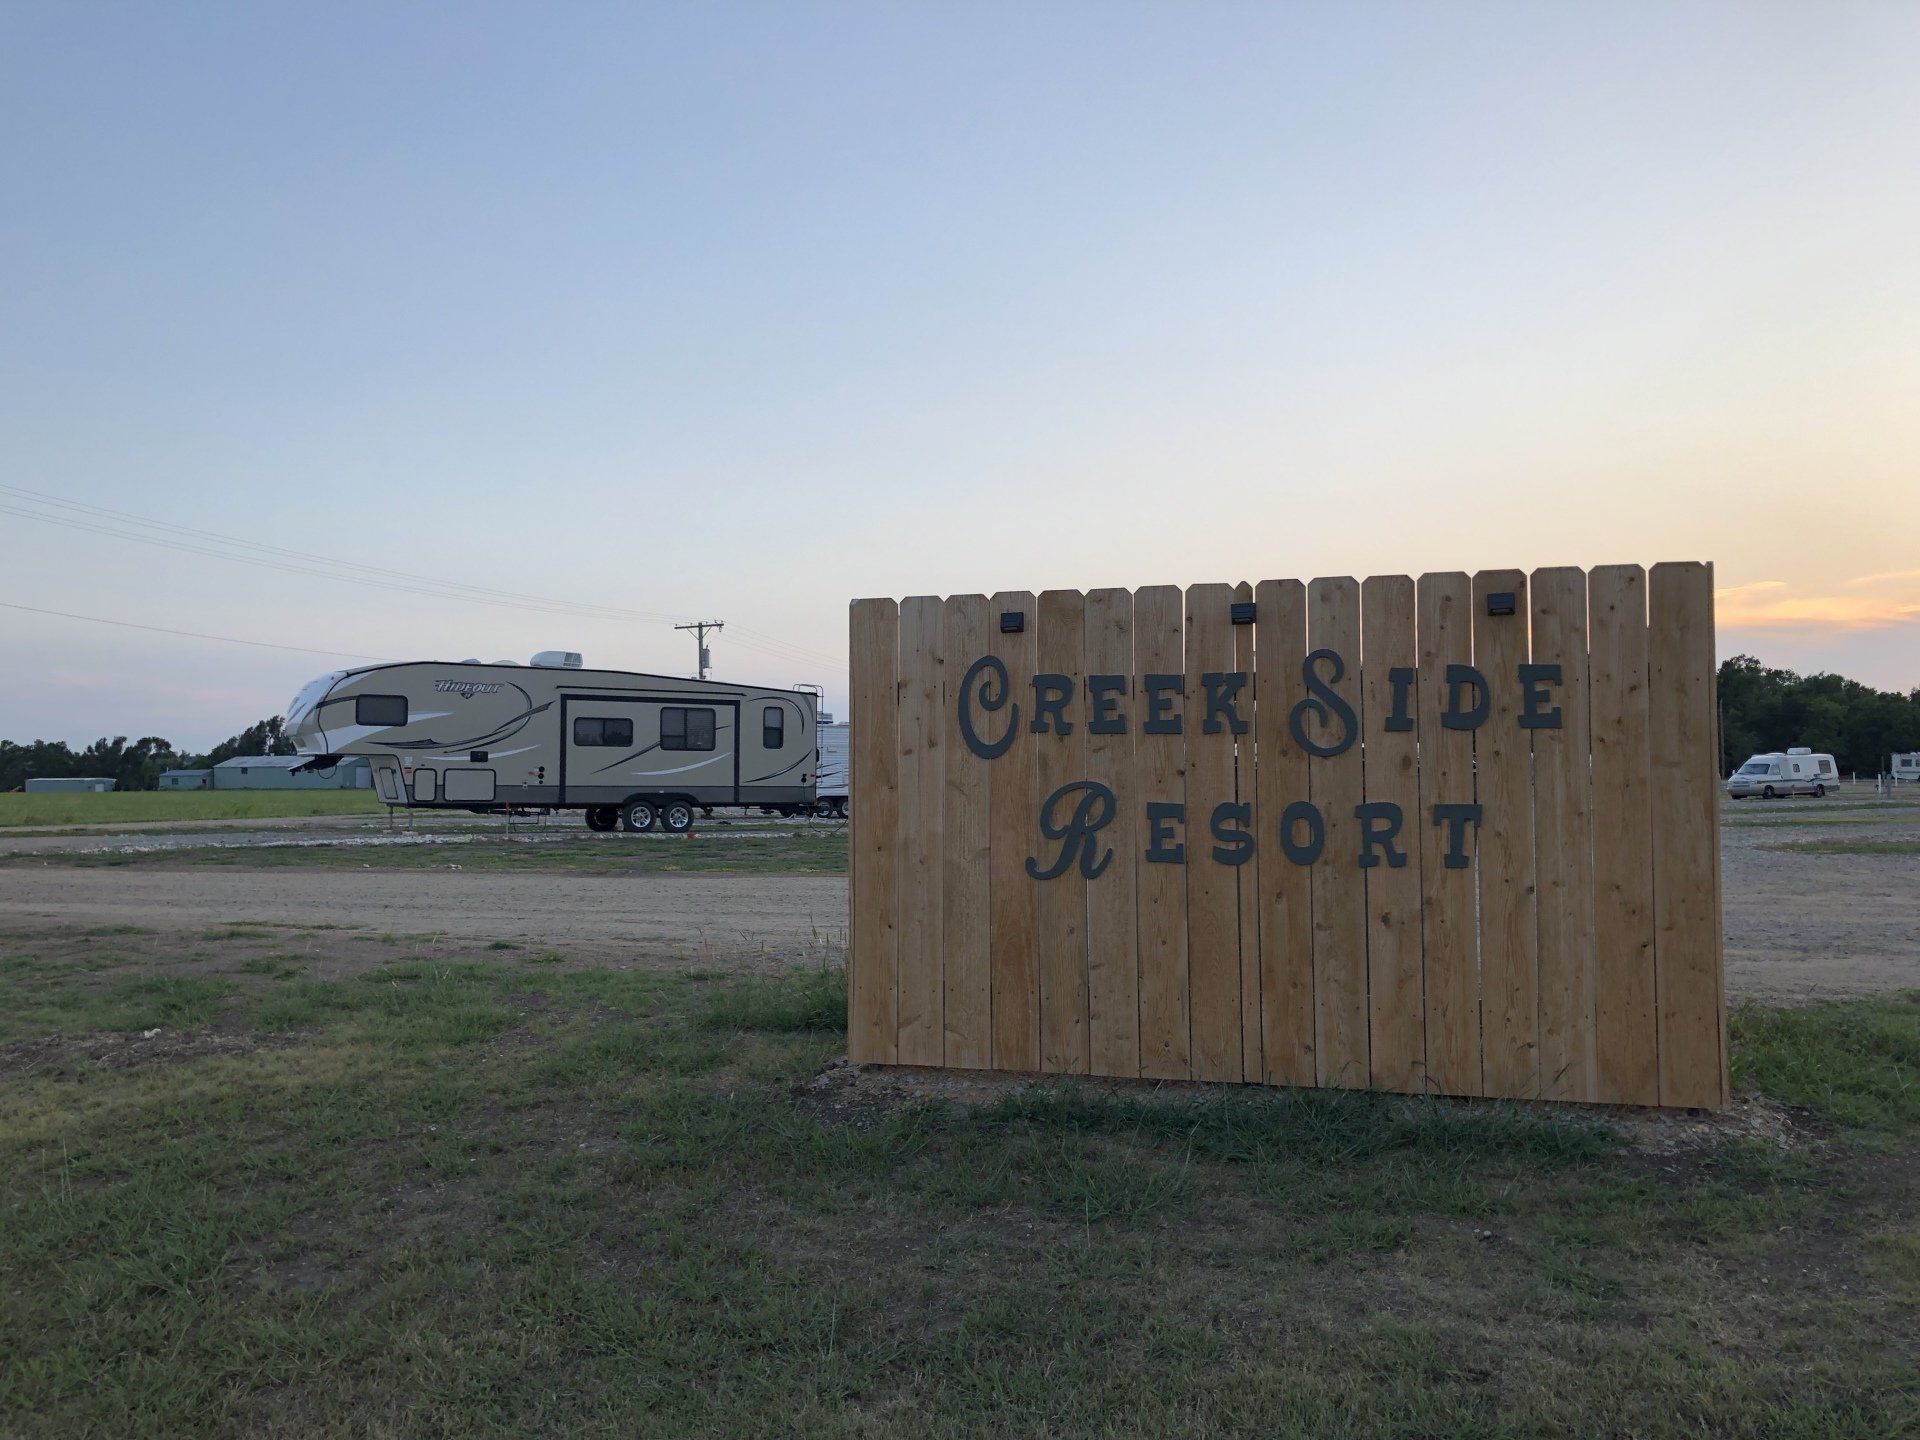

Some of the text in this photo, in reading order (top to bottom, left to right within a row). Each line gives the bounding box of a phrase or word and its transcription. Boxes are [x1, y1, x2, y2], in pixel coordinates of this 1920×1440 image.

[435, 679, 504, 693] HIDEOUT
[958, 648, 1563, 759] CREEK SIDE
[1025, 780, 1483, 880] RESORT
